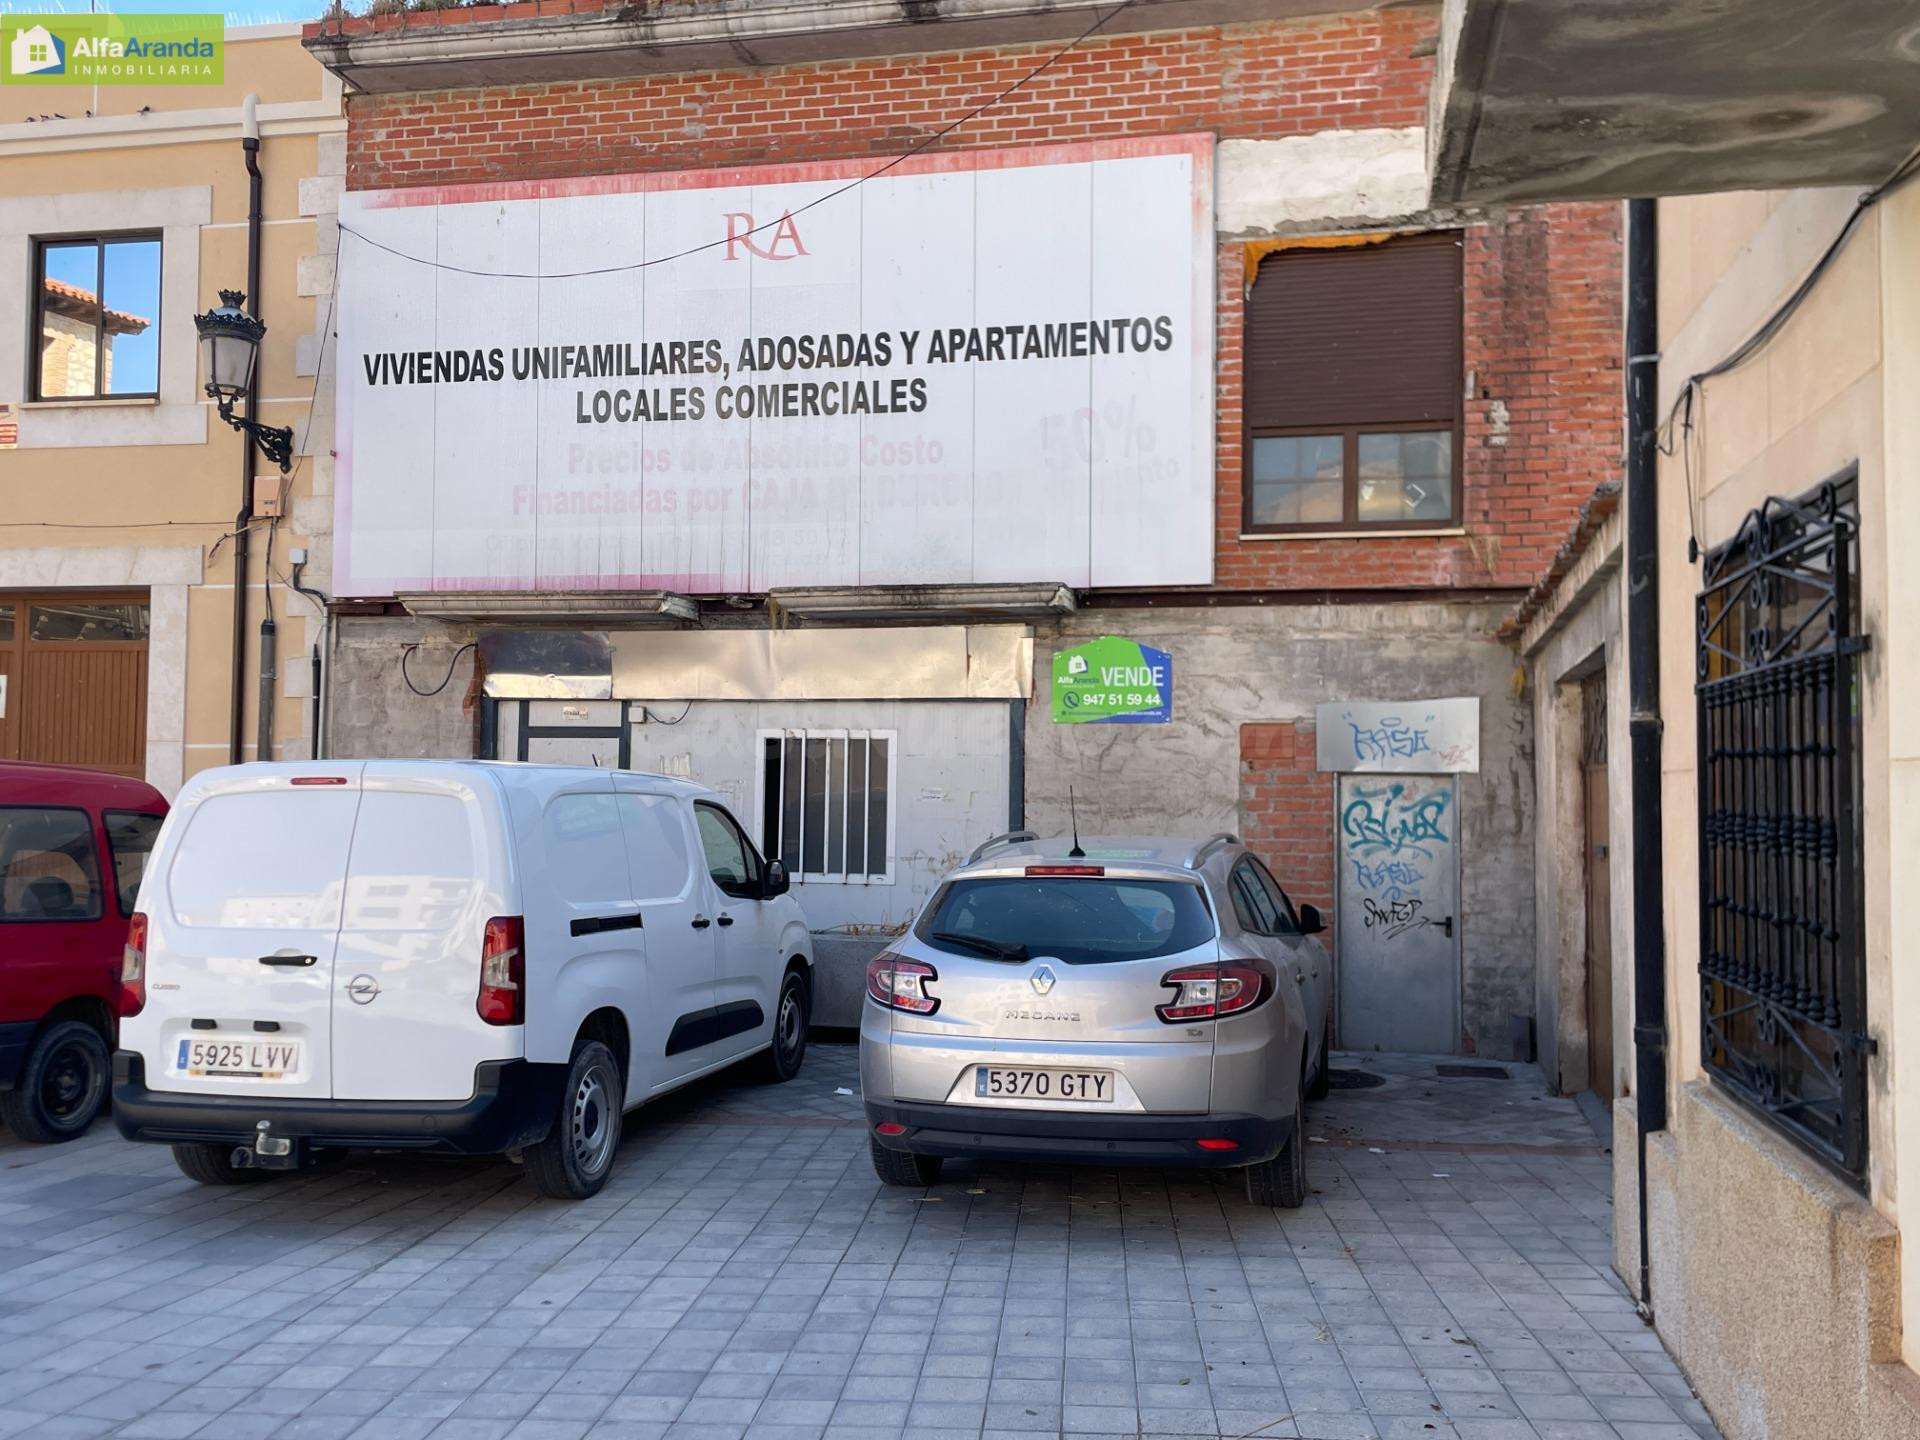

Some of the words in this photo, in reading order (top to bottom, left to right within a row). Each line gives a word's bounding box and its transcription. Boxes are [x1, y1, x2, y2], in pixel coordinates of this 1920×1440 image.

[363, 347, 505, 386] VIVIENDAS
[511, 338, 730, 381] UNIFAMILIARES,
[737, 331, 892, 372] ADOSADAS
[900, 330, 921, 366] Y
[927, 315, 1174, 364] APARTAMENTOS
[575, 386, 706, 425] LOCALES
[714, 377, 928, 420] COMERCIALES
[567, 440, 672, 475] Precios
[861, 433, 944, 467] Costo
[511, 482, 678, 516] Financiadas
[686, 486, 734, 522] por
[1100, 666, 1164, 687] VENDE
[1083, 693, 1105, 706] 947
[1108, 693, 1123, 706] 51
[1126, 693, 1142, 706] 59
[1144, 693, 1160, 706] 44
[192, 1044, 243, 1067] 5925
[250, 1046, 293, 1069] LVV
[990, 1071, 1050, 1095] 5370
[1060, 1073, 1106, 1098] GTY
